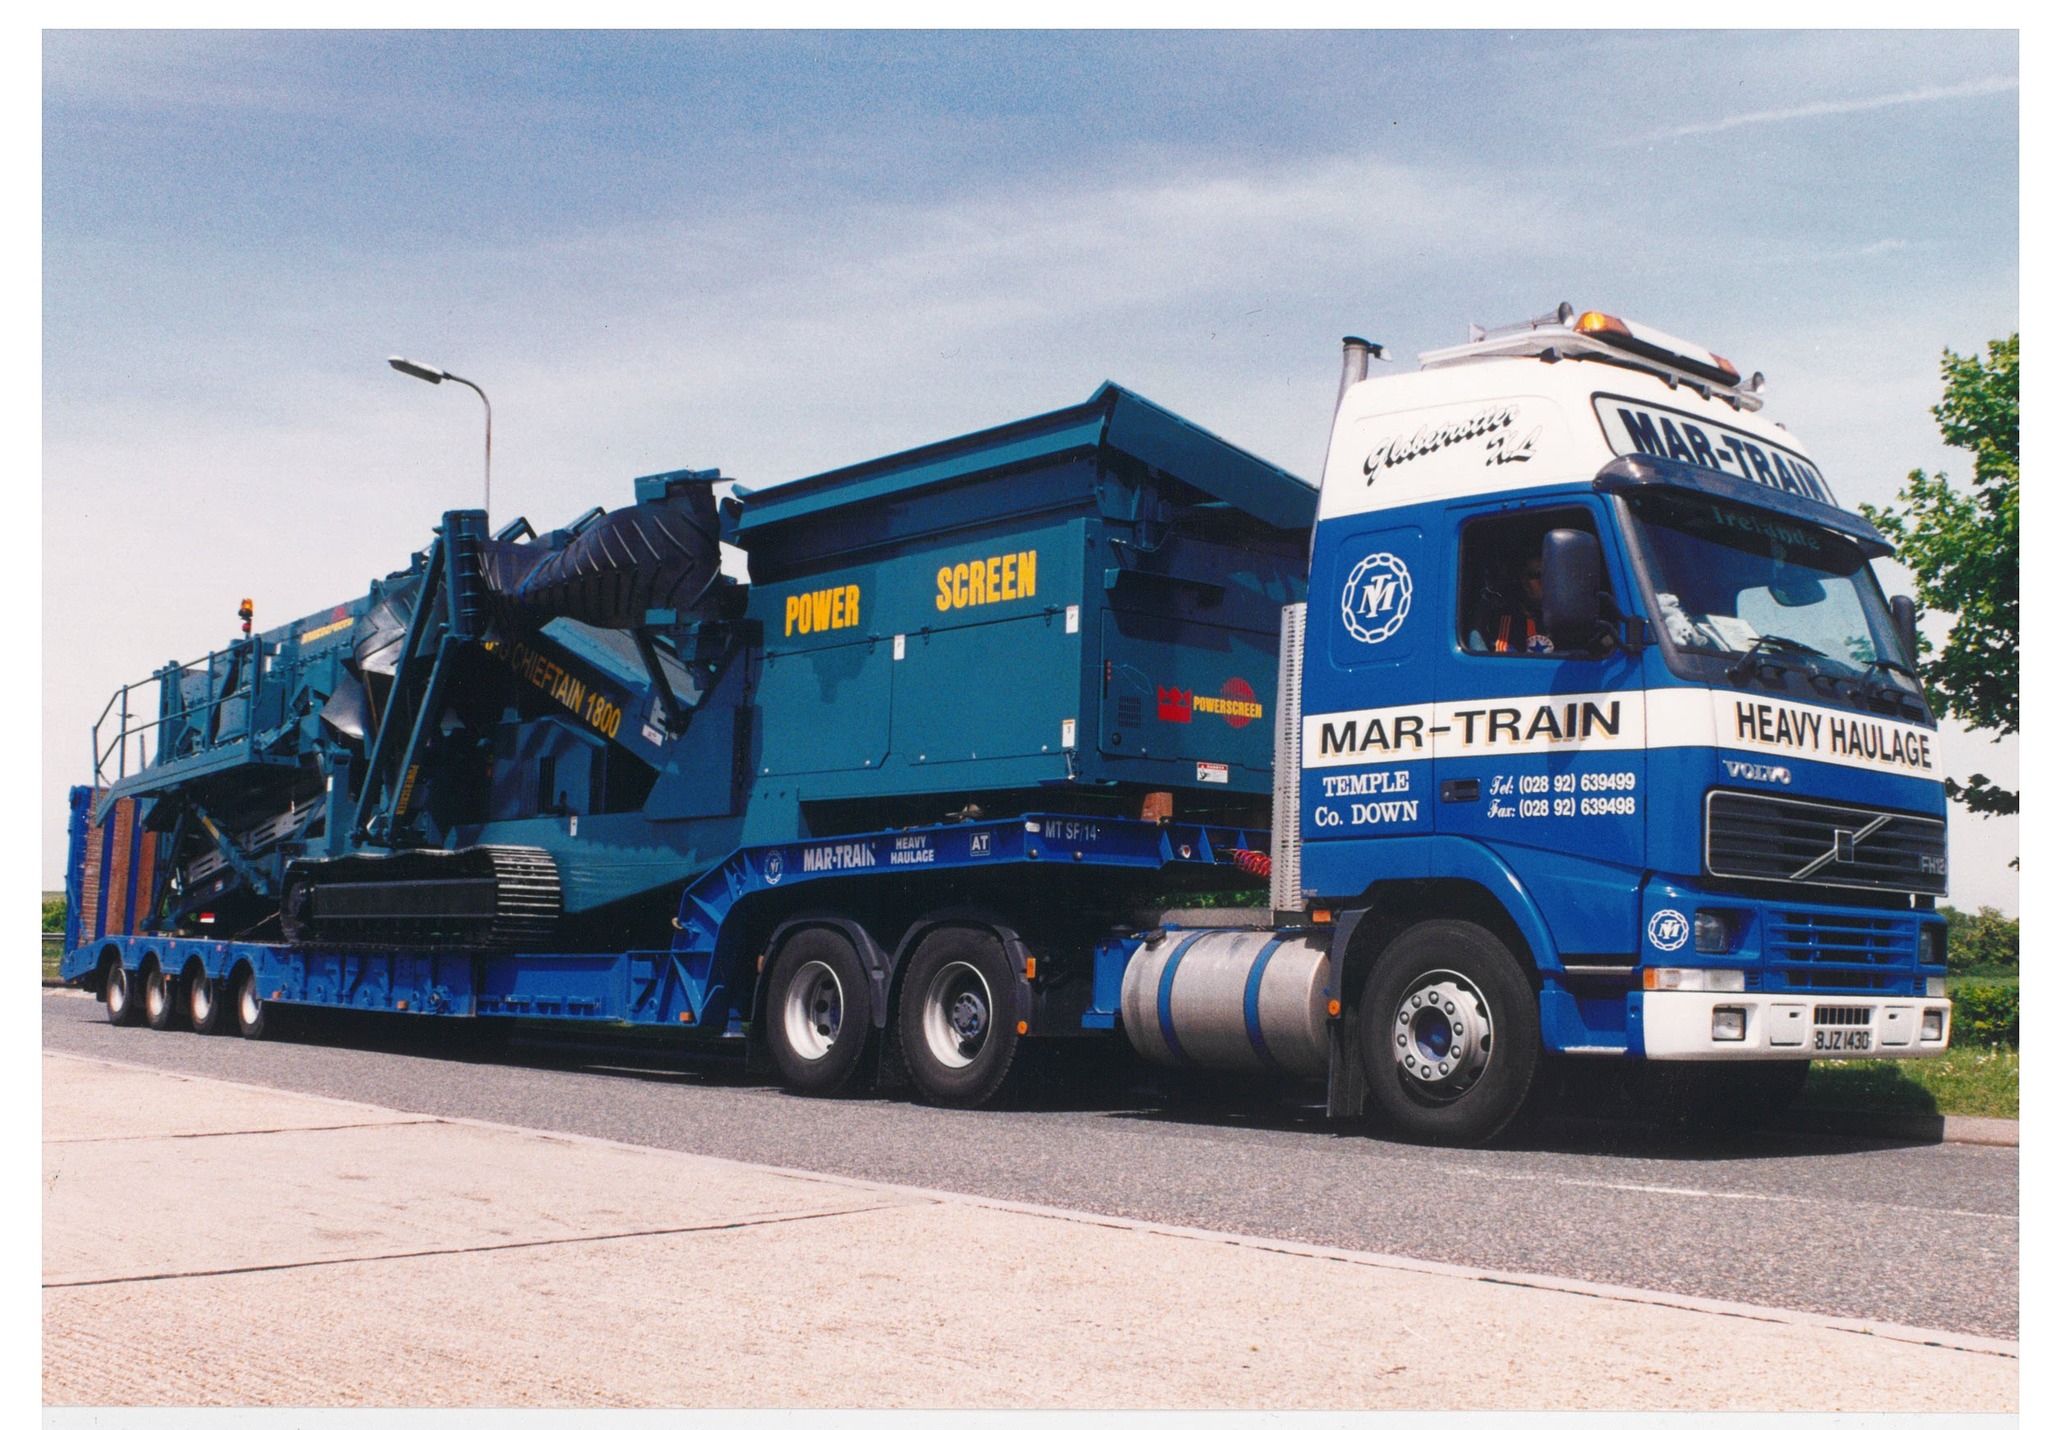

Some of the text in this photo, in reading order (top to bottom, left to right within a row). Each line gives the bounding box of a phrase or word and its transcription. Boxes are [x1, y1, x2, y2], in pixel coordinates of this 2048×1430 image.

[1363, 404, 1520, 487] Globetrotter
[1486, 425, 1543, 467] XL
[1616, 408, 1829, 505] MAR-TRAIN
[785, 550, 1037, 637] POWER SCREEN
[512, 642, 622, 739] CHIEFTAIN 1800
[1193, 696, 1262, 718] POWERSCREEN
[1318, 700, 1621, 758] MAR-TRAIN
[1735, 701, 1933, 772] HEAVY HAULAGE
[1322, 771, 1410, 797] TEMPLE
[1489, 772, 1636, 796] Tel: (028 92) 639499
[1722, 759, 1793, 785] VOLVO
[1315, 800, 1420, 827] Co. DOWN
[1487, 796, 1636, 819] Fax: (028 92) 639498
[1045, 820, 1063, 839] MT
[890, 848, 934, 864] HAULAGE
[895, 836, 926, 850] HEAVY
[972, 835, 989, 851] AT
